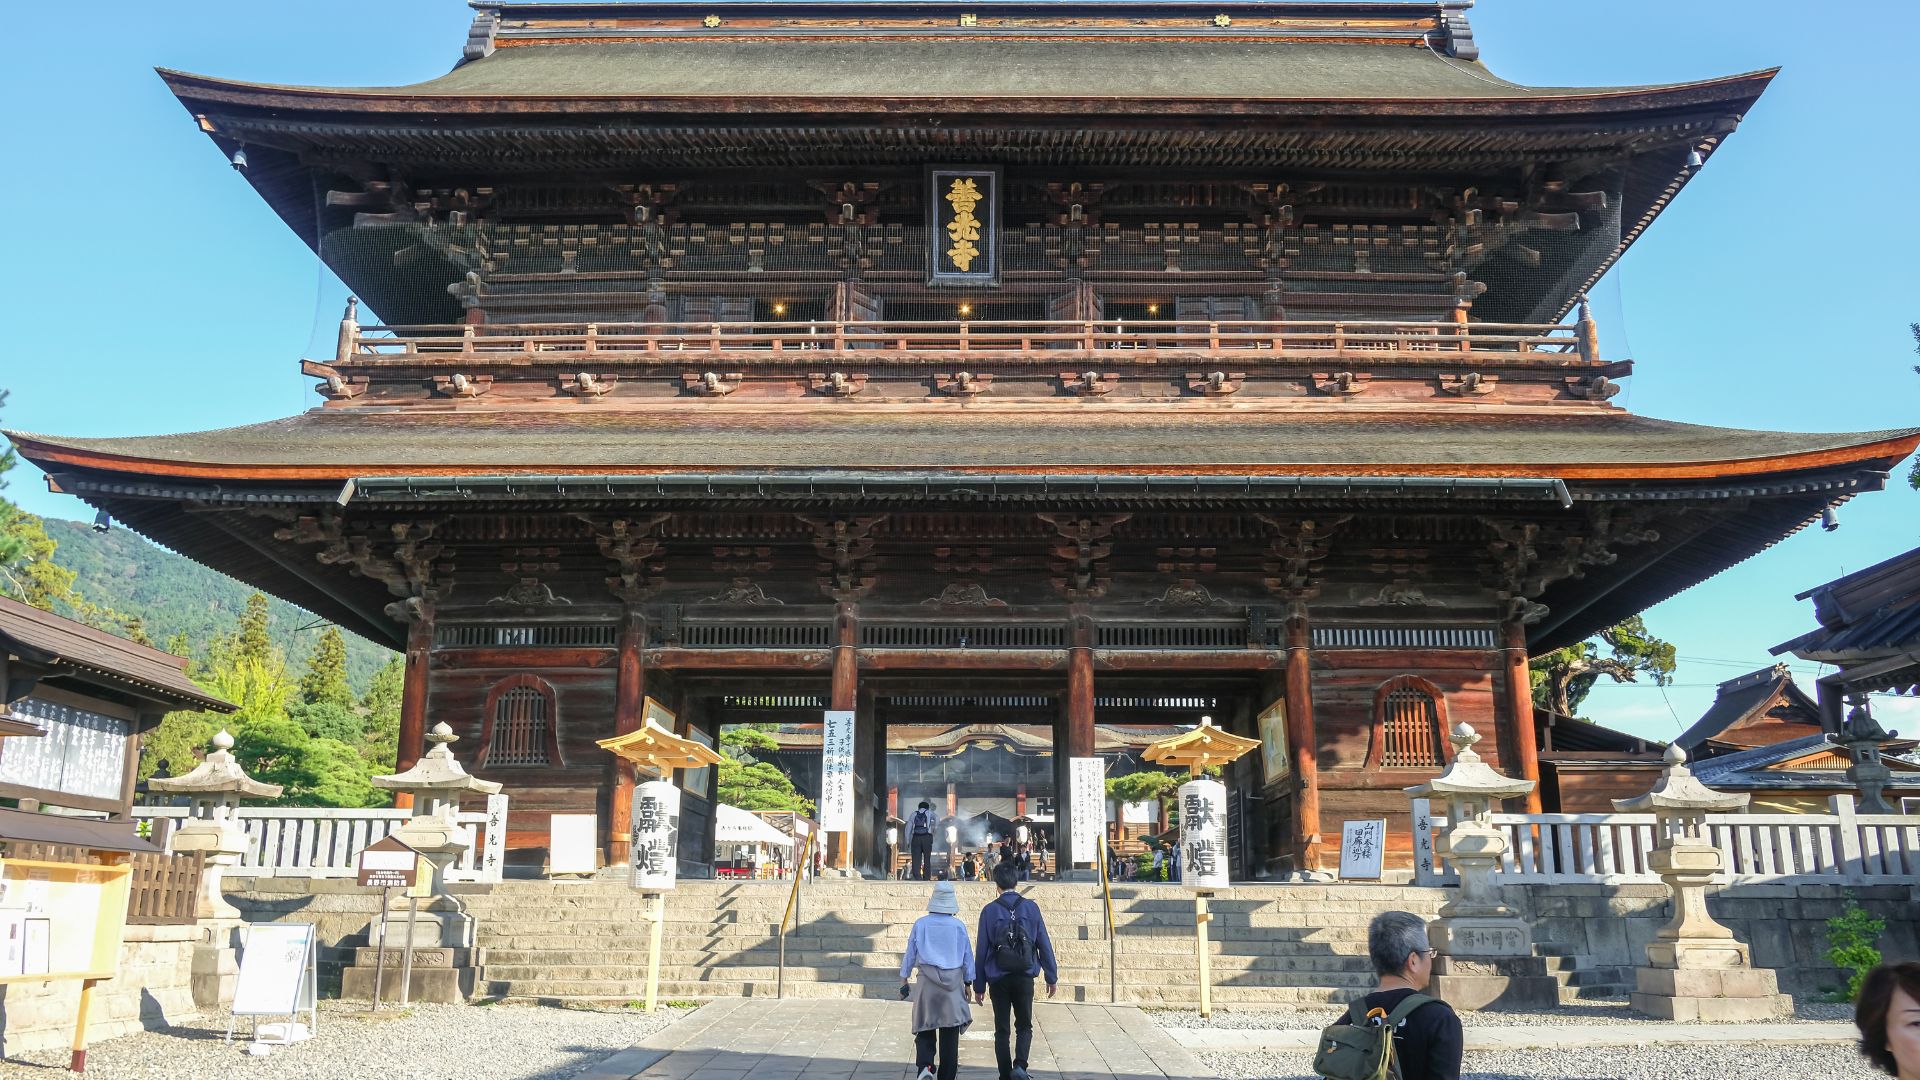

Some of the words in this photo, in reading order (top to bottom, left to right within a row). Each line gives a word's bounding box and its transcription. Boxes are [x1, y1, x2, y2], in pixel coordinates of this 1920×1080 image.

[946, 178, 982, 272] 善光寺
[486, 812, 500, 867] 善光寺
[1417, 815, 1432, 871] 善光寺
